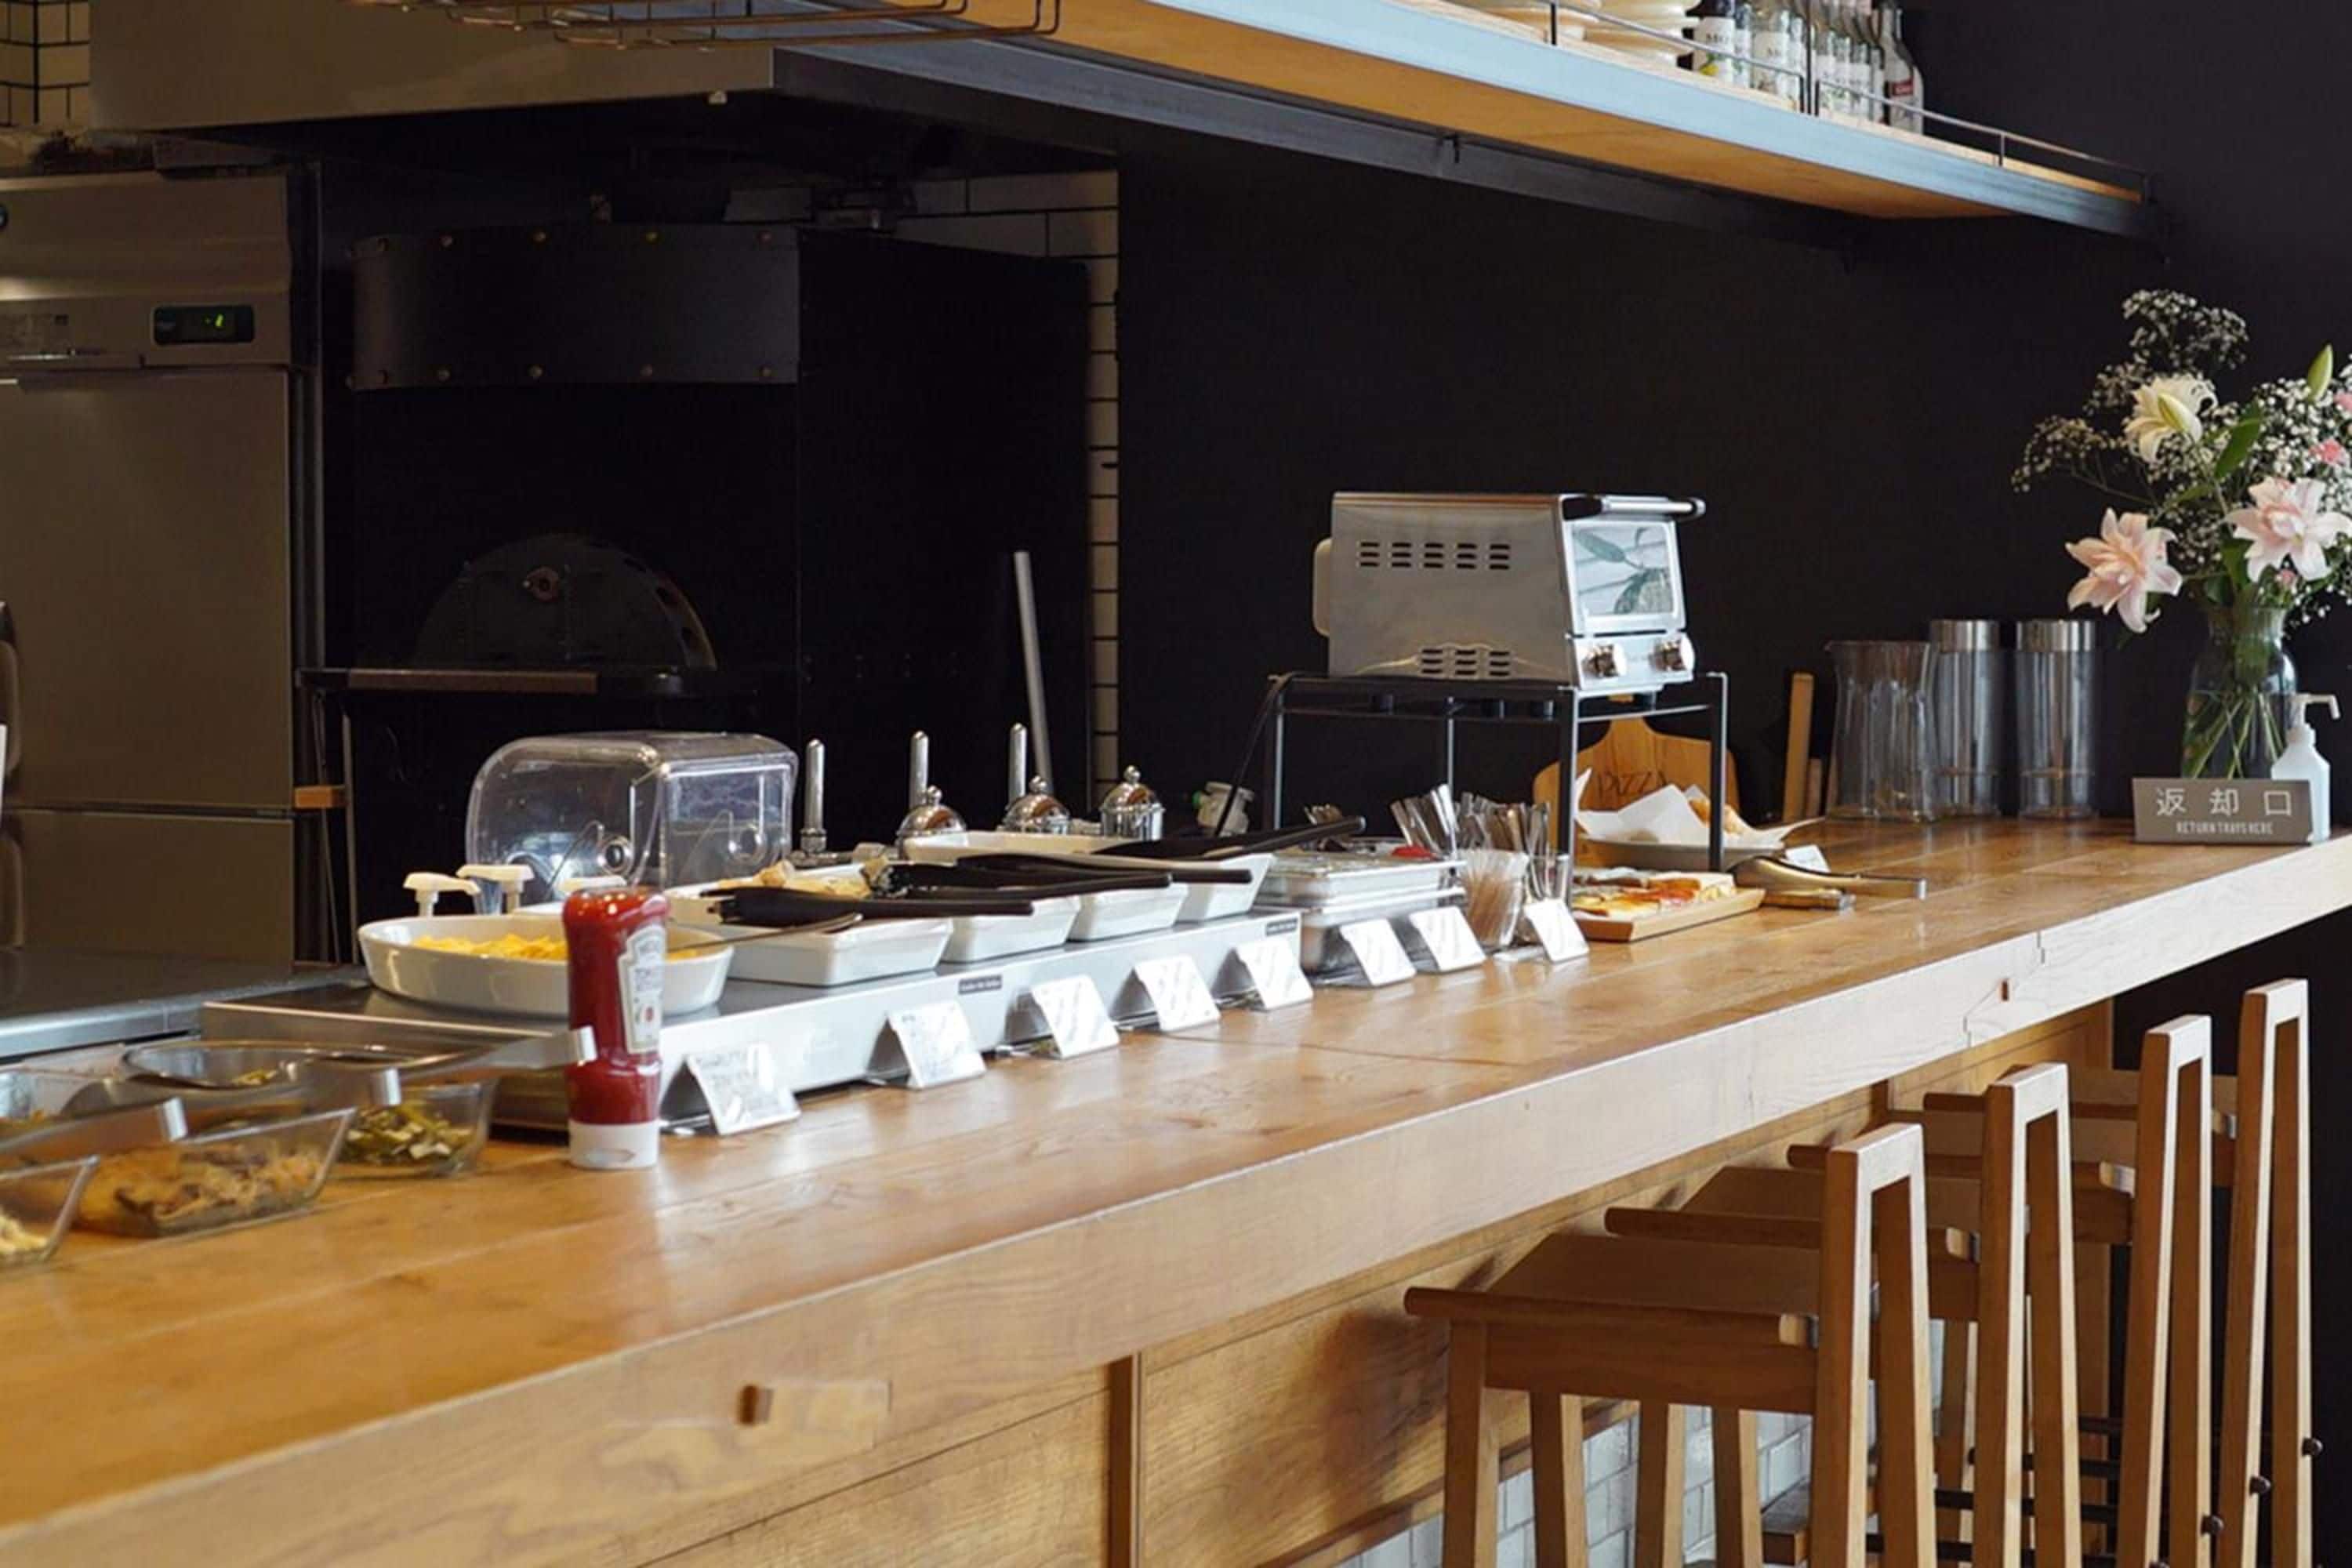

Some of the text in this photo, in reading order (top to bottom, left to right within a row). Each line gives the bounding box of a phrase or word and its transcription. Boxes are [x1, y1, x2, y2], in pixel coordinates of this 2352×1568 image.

[2156, 787, 2292, 816] 返却口
[2176, 821, 2216, 834] RETURN
[2249, 821, 2274, 834] HERE
